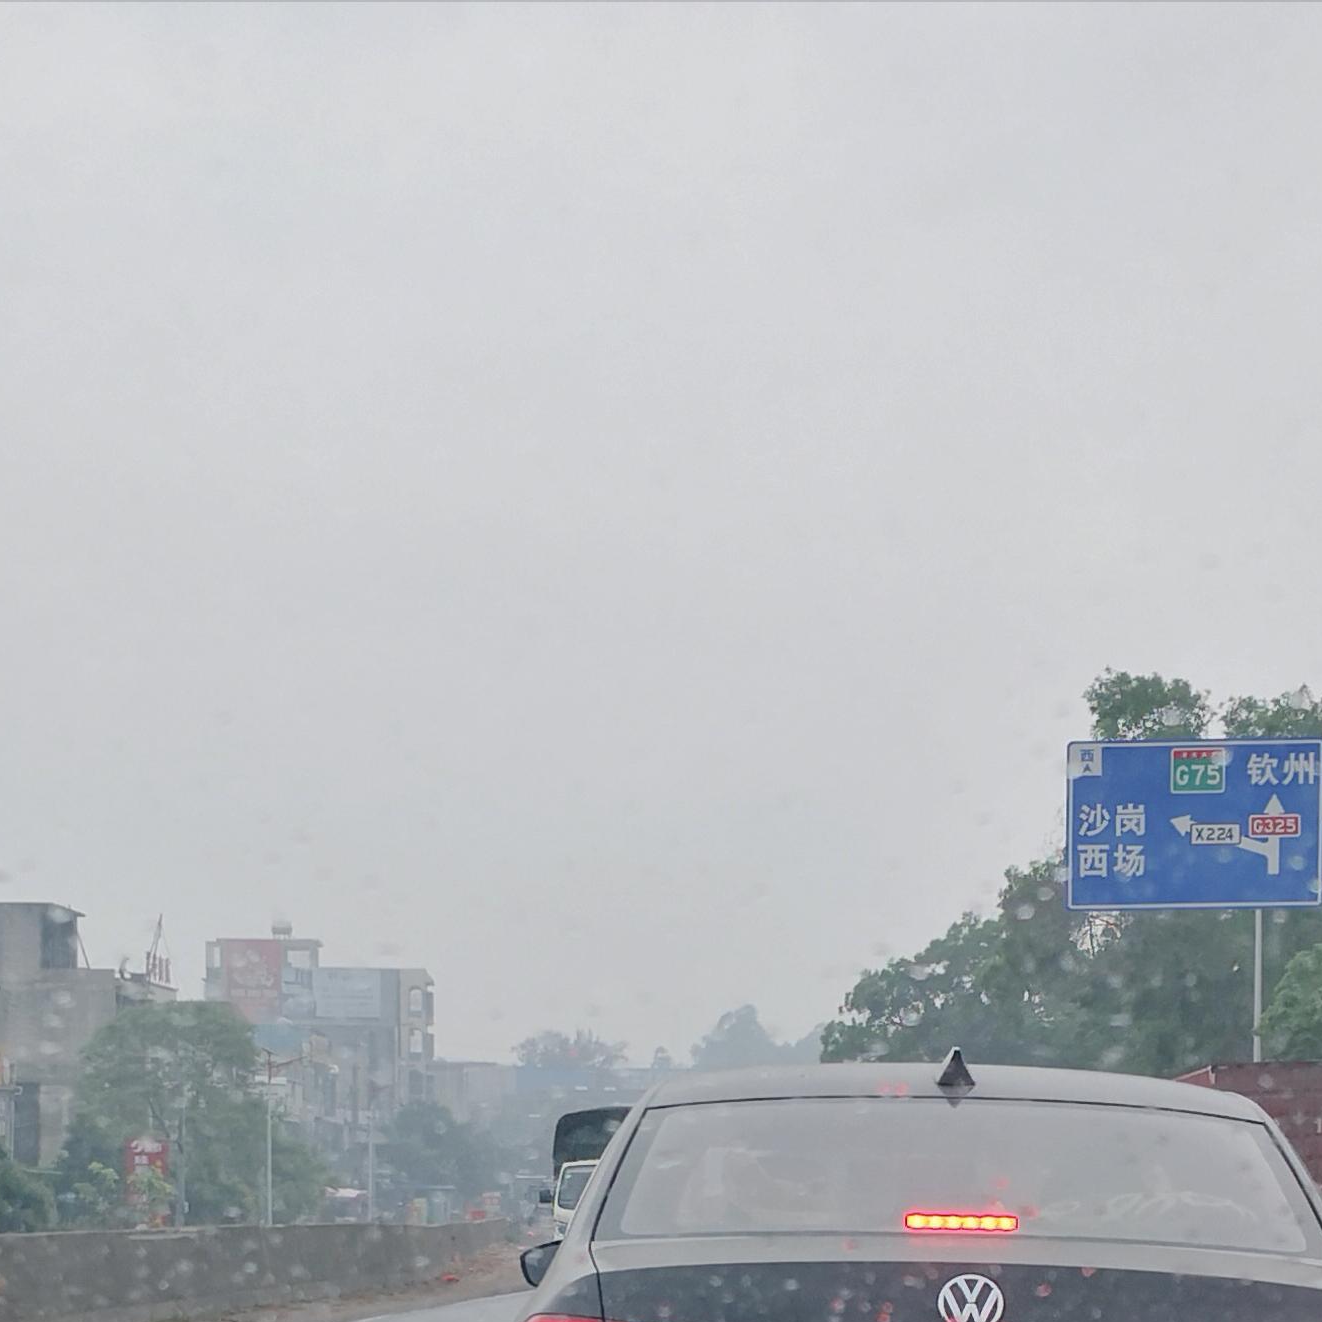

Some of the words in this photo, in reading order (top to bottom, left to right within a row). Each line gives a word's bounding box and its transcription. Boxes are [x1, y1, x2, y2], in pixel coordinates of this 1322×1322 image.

[1176, 765, 1220, 785] G75
[1248, 752, 1315, 786] 钦州
[1078, 803, 1145, 837] 沙岗
[1252, 817, 1297, 834] G325
[1195, 827, 1234, 842] X224
[1077, 844, 1145, 878] 西场
